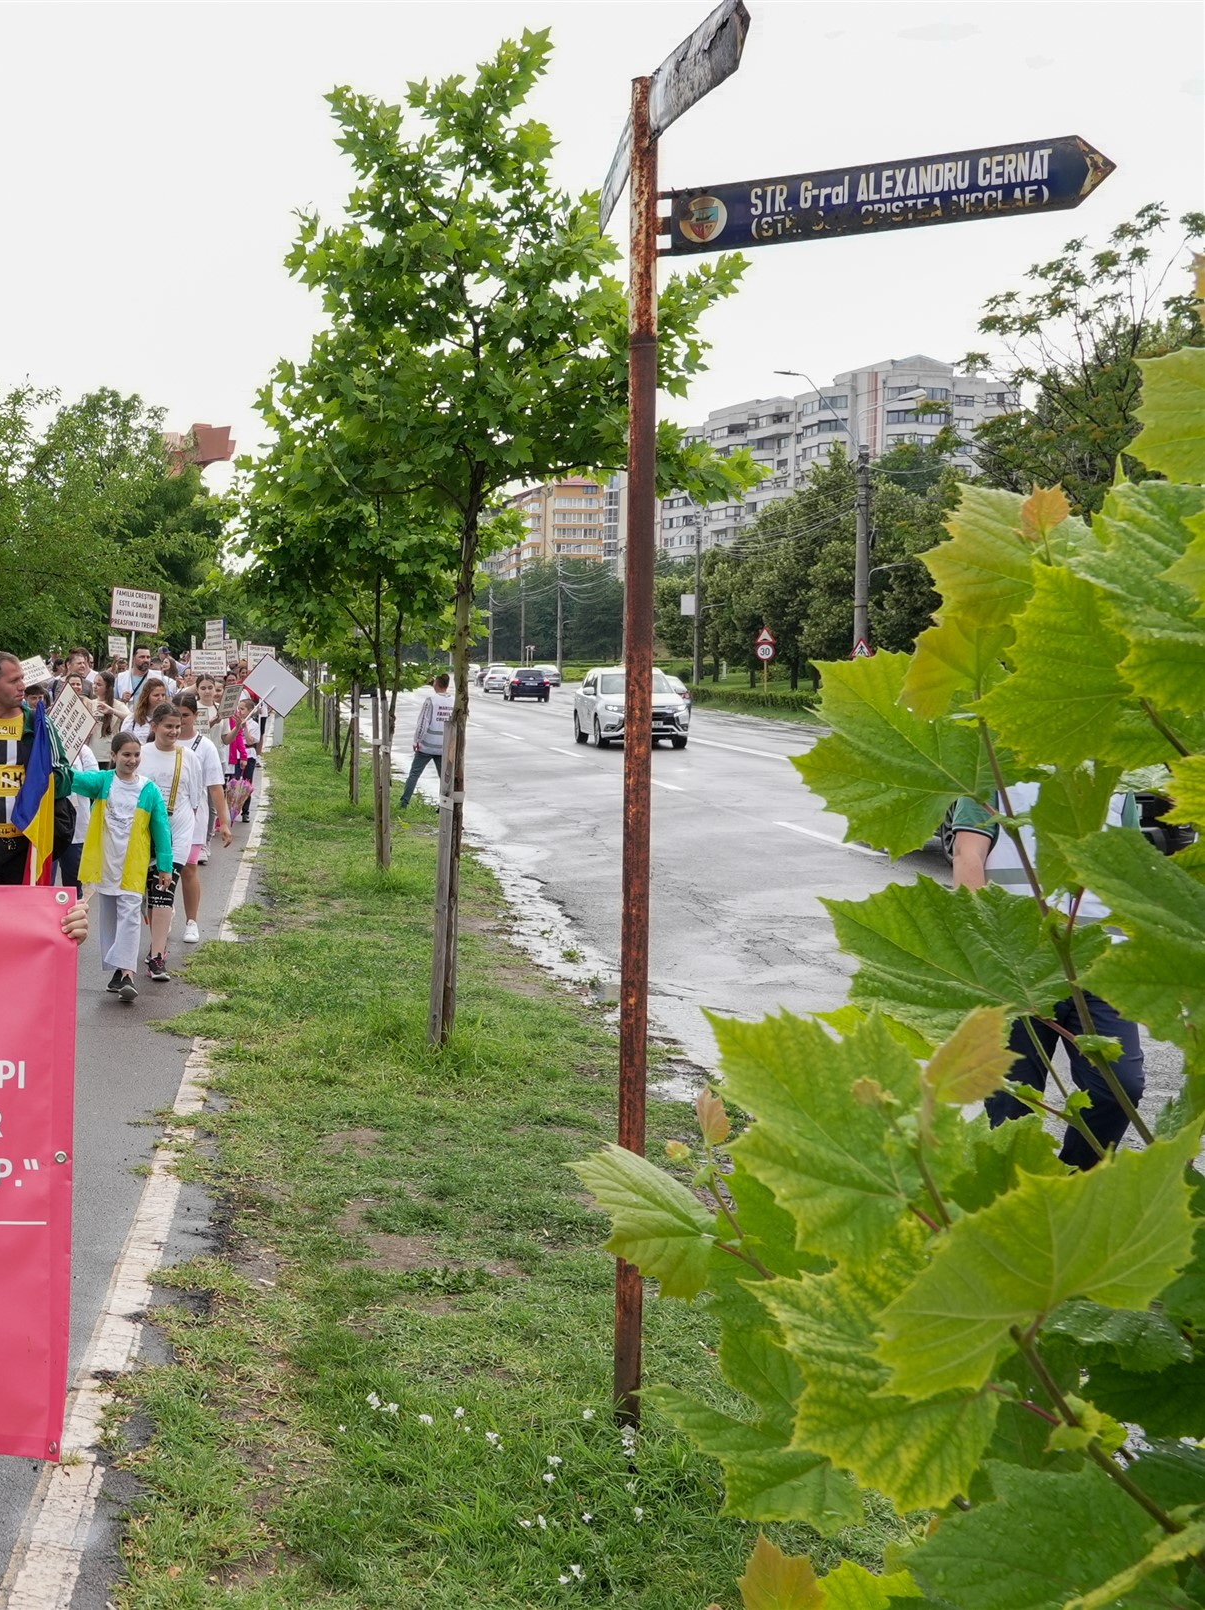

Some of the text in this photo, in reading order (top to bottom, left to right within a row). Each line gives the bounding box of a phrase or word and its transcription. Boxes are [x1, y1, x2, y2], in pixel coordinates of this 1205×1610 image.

[750, 148, 1052, 216] STR. G-ral ALEXANDRU CERNAT
